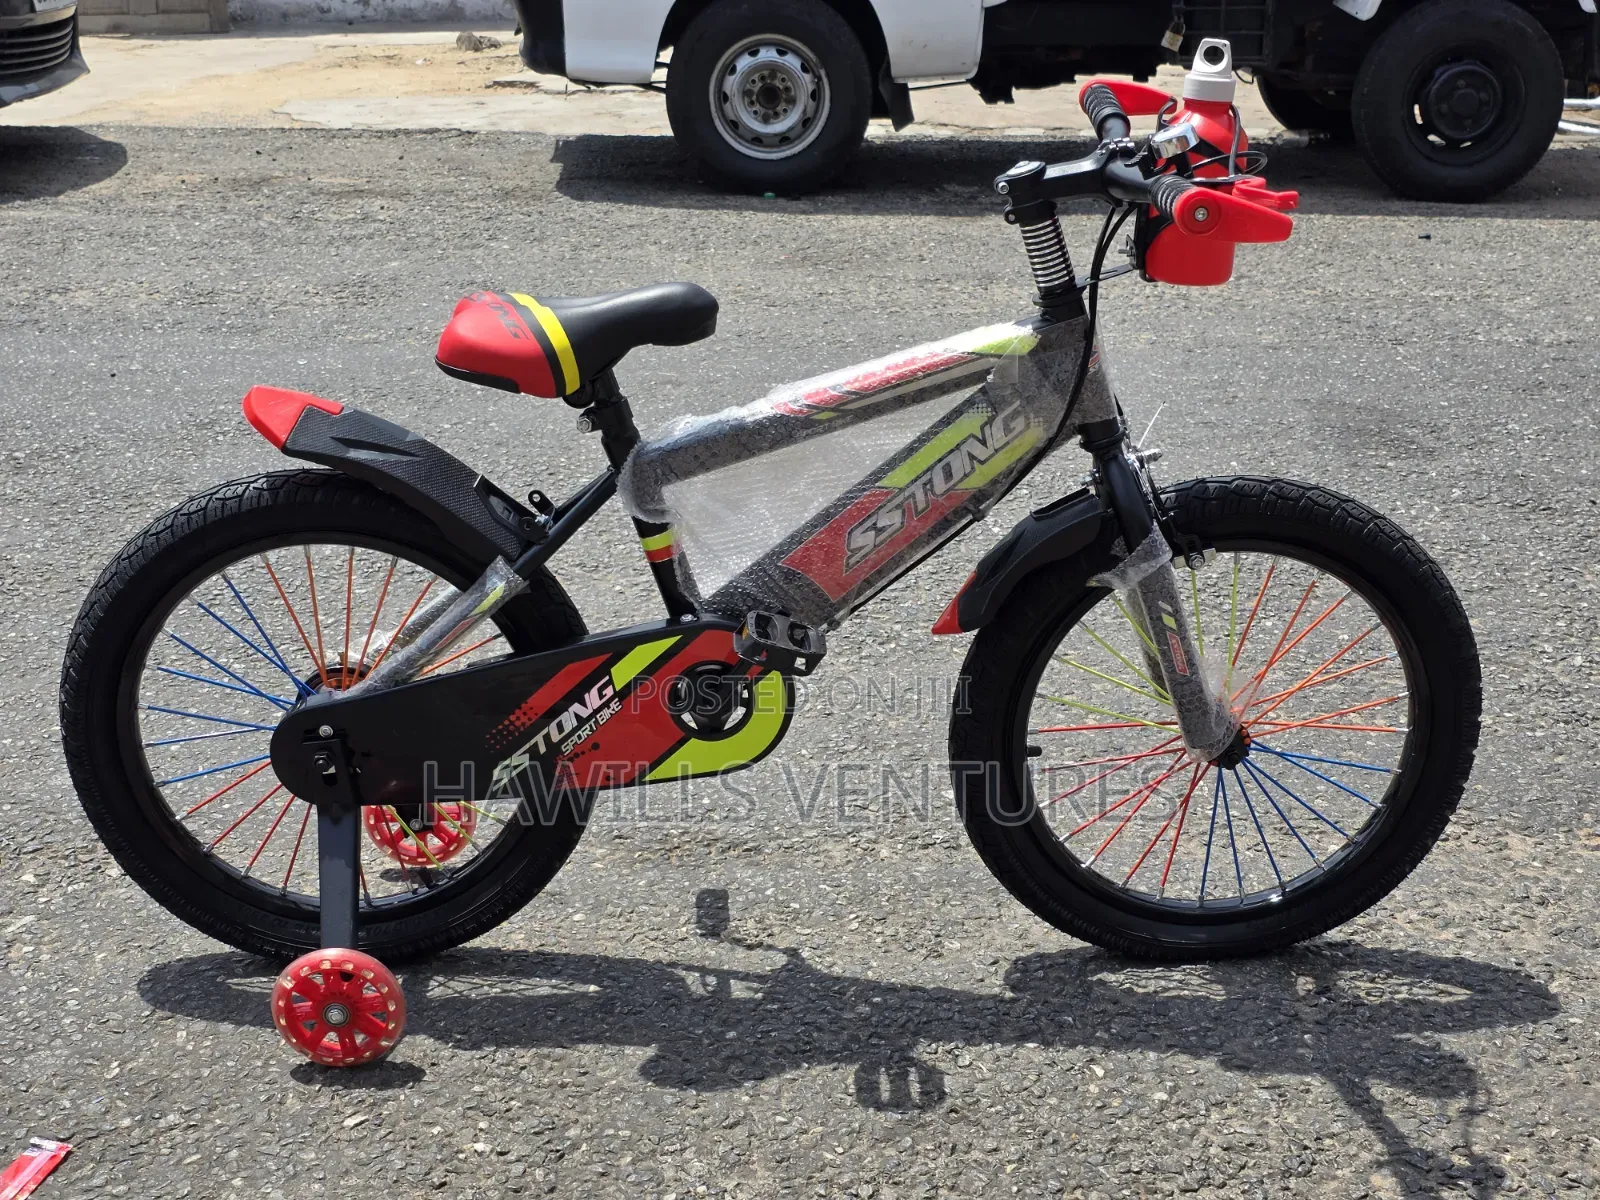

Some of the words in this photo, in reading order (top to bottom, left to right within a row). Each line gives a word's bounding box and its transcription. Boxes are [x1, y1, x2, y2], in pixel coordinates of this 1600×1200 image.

[844, 399, 1027, 575] SSTONG
[492, 675, 615, 792] SSTONG
[561, 717, 597, 756] SPORT
[595, 697, 623, 726] BIKE
